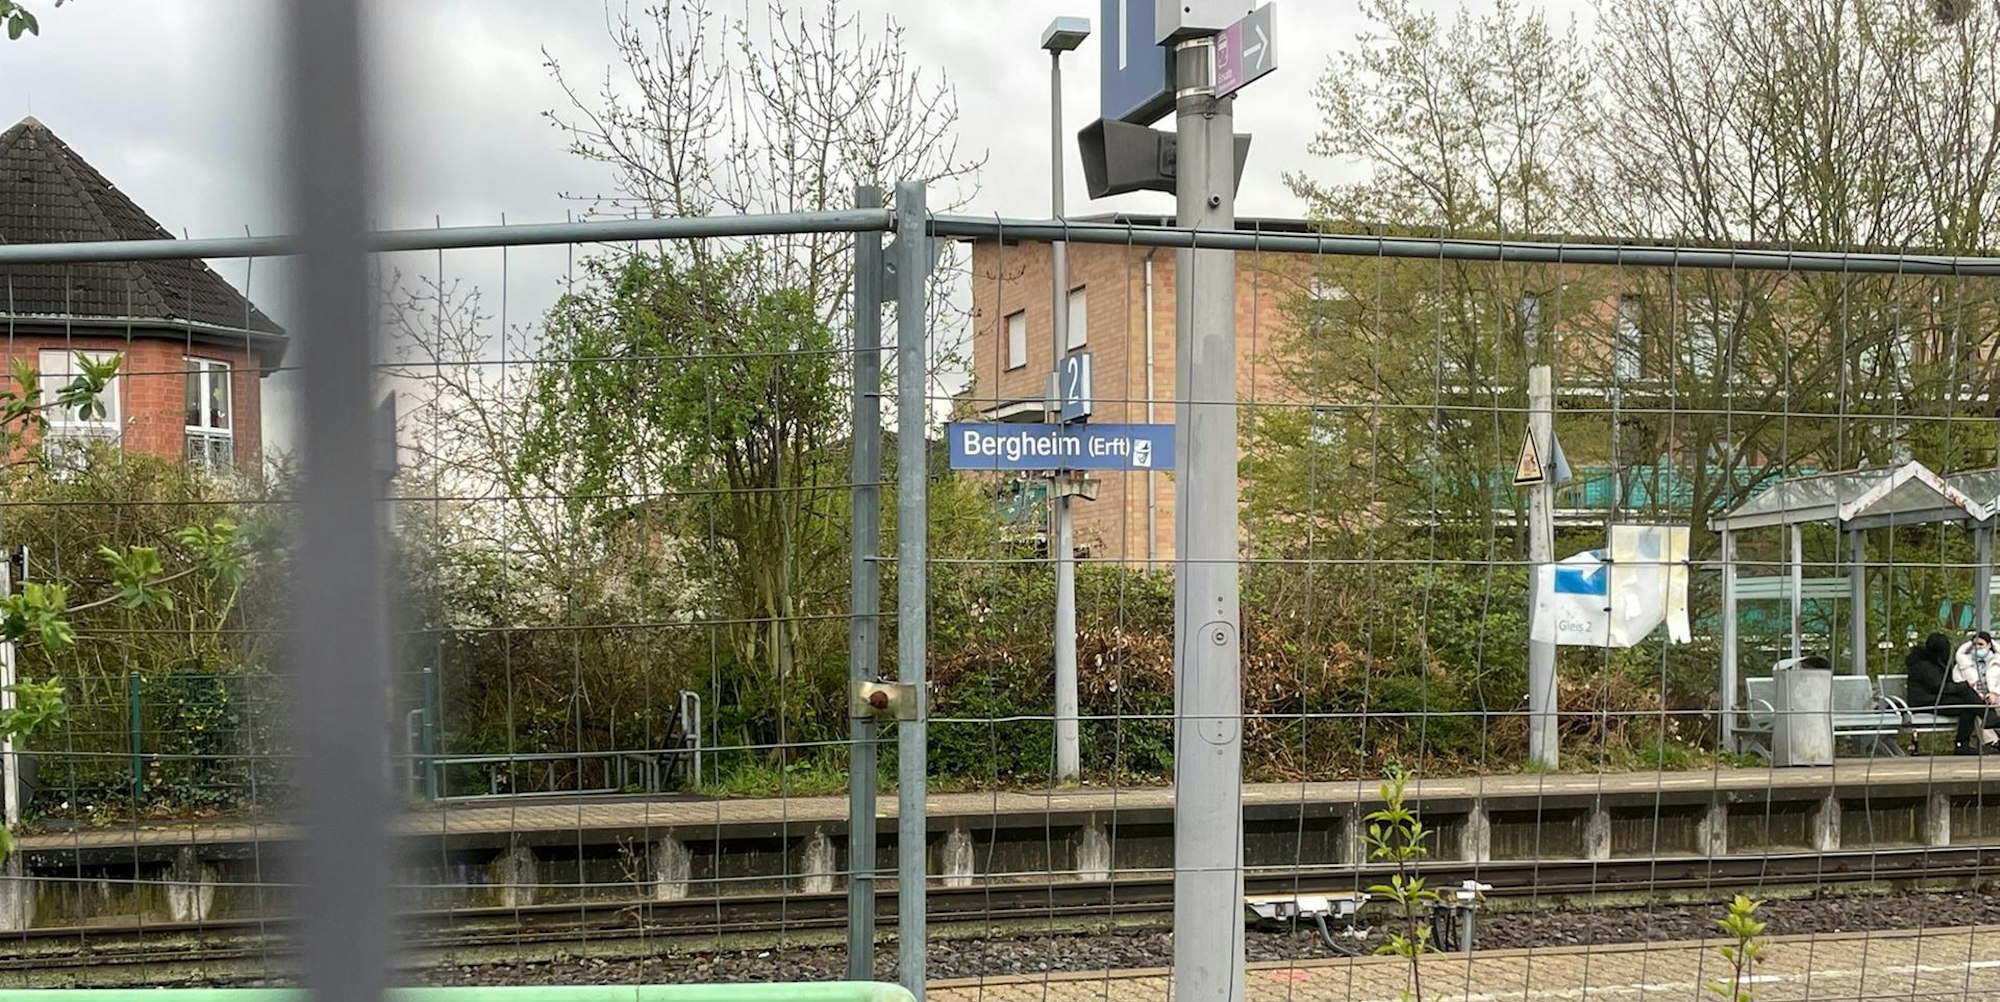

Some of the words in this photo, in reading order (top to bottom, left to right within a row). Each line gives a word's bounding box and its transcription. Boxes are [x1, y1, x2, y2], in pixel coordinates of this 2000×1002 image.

[1067, 357, 1079, 405] 2
[963, 430, 1081, 460] Bergheim
[1088, 435, 1131, 458] (Erft)
[1558, 619, 1585, 632] Gleis
[1585, 621, 1593, 633] 2
